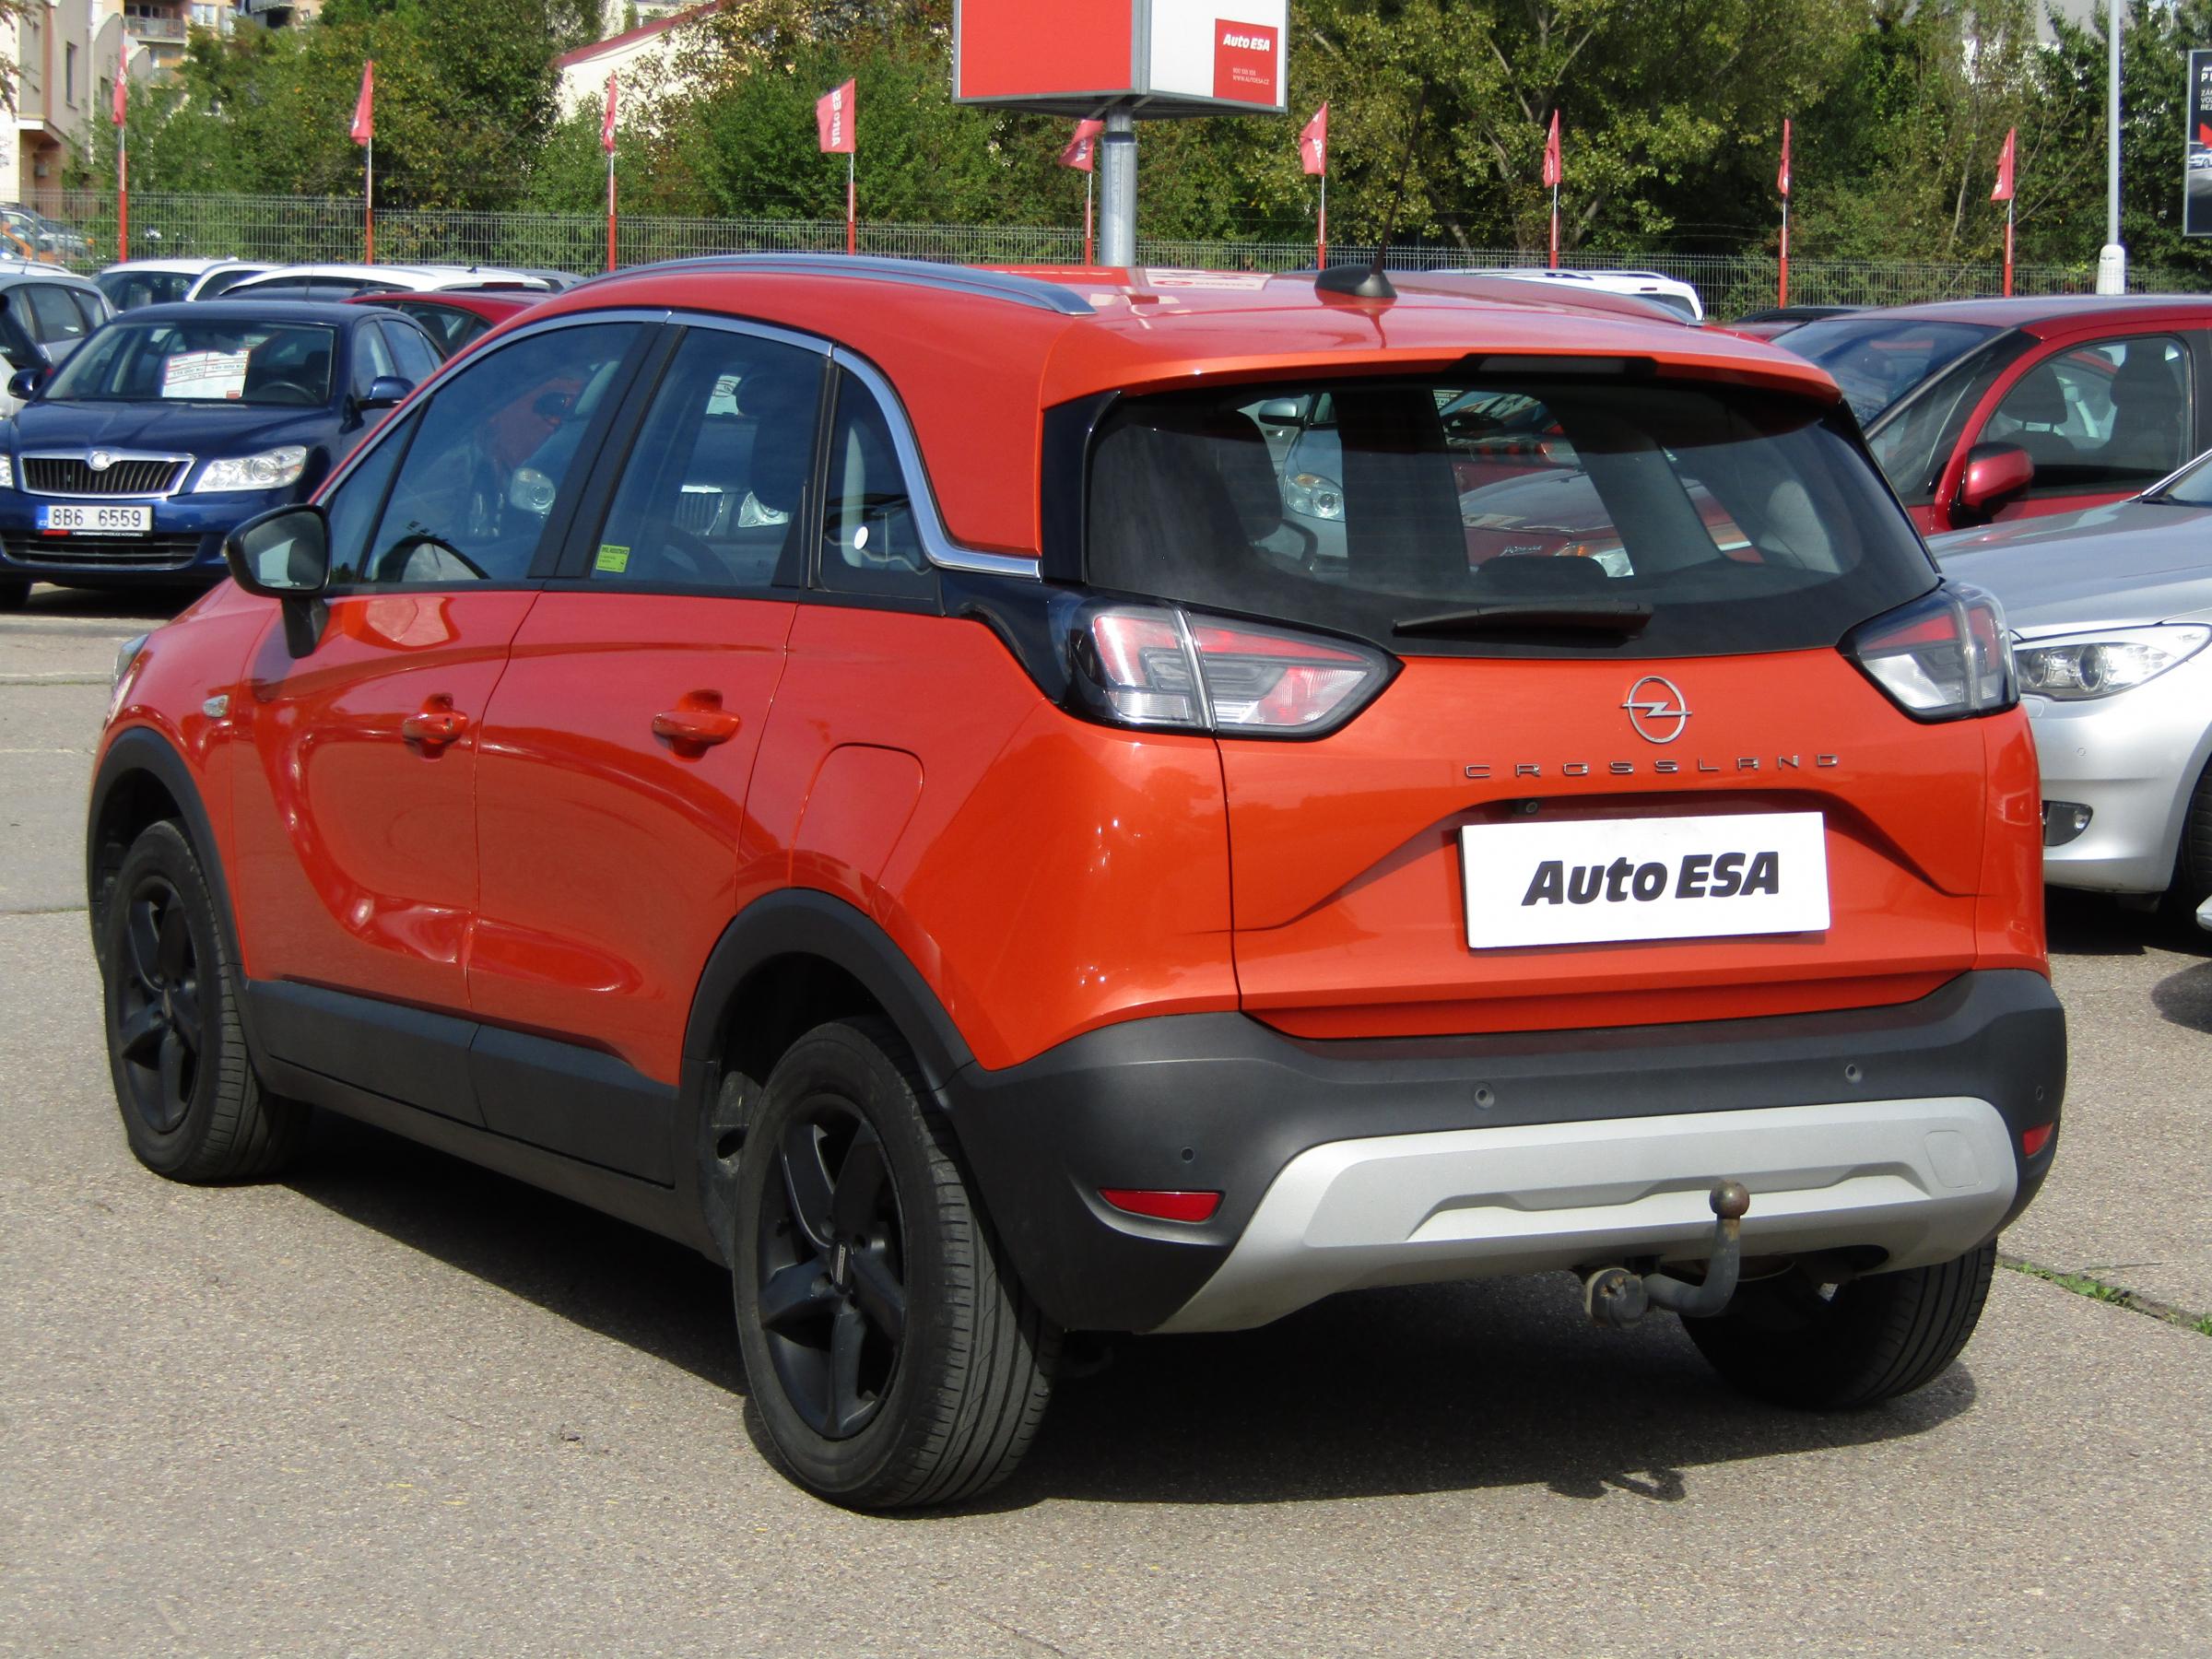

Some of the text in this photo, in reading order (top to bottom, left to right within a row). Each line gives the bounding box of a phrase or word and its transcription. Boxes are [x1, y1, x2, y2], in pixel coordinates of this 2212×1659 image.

[1223, 33, 1271, 52] Auto ESA
[53, 509, 142, 527] 8B6 6559
[1465, 753, 1840, 779] CROSSLAND
[1521, 852, 1779, 906] Auto ESA
